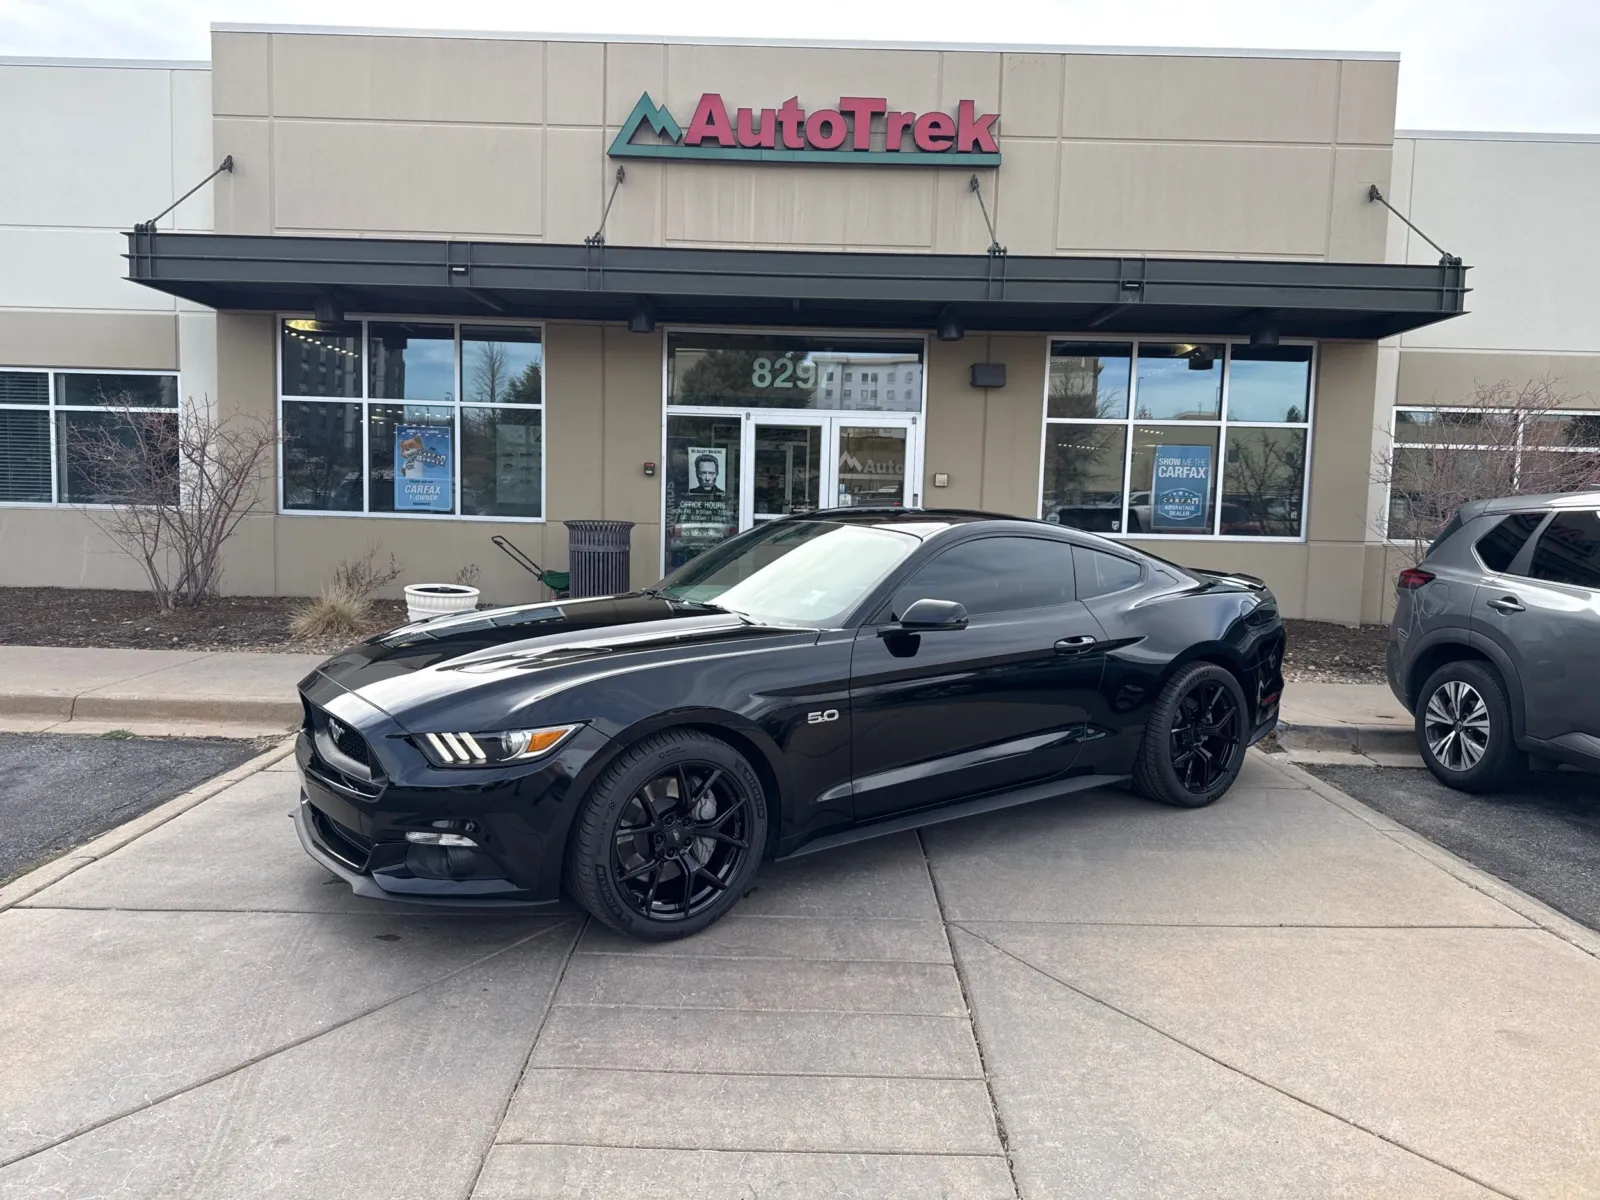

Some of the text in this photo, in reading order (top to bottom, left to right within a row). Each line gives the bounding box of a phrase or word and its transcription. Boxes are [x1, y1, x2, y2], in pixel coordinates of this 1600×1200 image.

[683, 93, 1000, 154] AutoTrek
[864, 459, 904, 474] Auto
[1158, 457, 1207, 467] SHOW ME THE
[1158, 466, 1206, 479] CARFAX
[404, 484, 441, 495] CARFAX
[680, 500, 726, 509] OFFICE HOURS
[807, 709, 839, 724] 5.0
